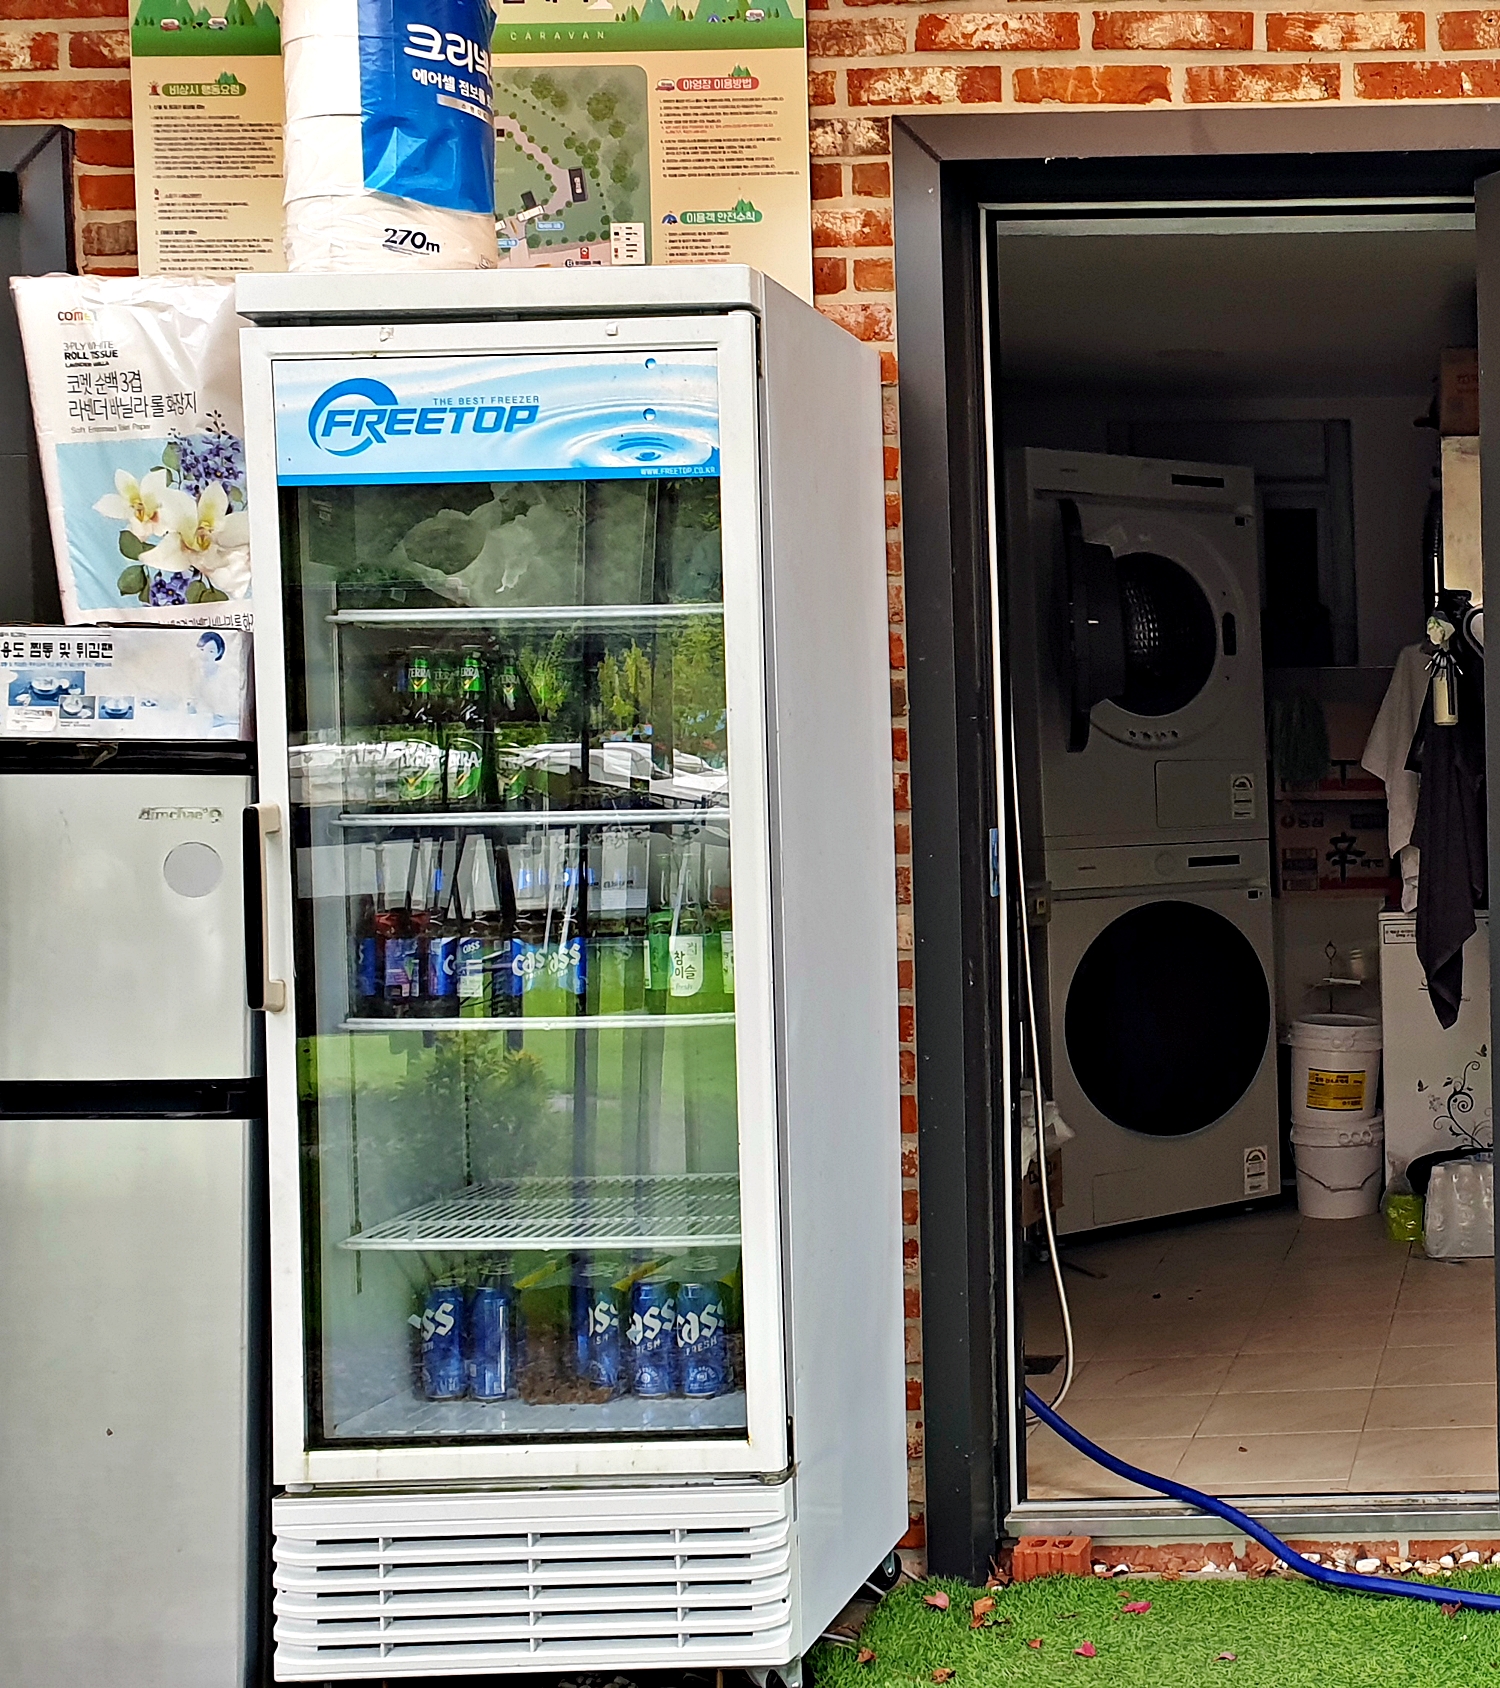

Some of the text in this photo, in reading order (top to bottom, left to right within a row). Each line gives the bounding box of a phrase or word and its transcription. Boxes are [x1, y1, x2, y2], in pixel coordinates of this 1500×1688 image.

[511, 31, 605, 41] CARAVAN
[412, 68, 456, 93] 에어셀
[169, 84, 199, 95] 비상시
[383, 228, 441, 253] 270m
[65, 351, 89, 360] ROLL
[67, 369, 142, 395] 코멧 순백 3겹
[110, 395, 149, 419] 바닐라
[151, 394, 165, 418] 롤
[166, 391, 198, 415] 화장지
[433, 395, 540, 406] THE BEST FREEZER
[321, 404, 541, 444] FREETOP
[30, 642, 54, 659] 찜통
[59, 642, 71, 659] 및
[76, 642, 113, 659] 튀김팬
[408, 667, 432, 680] TERRA
